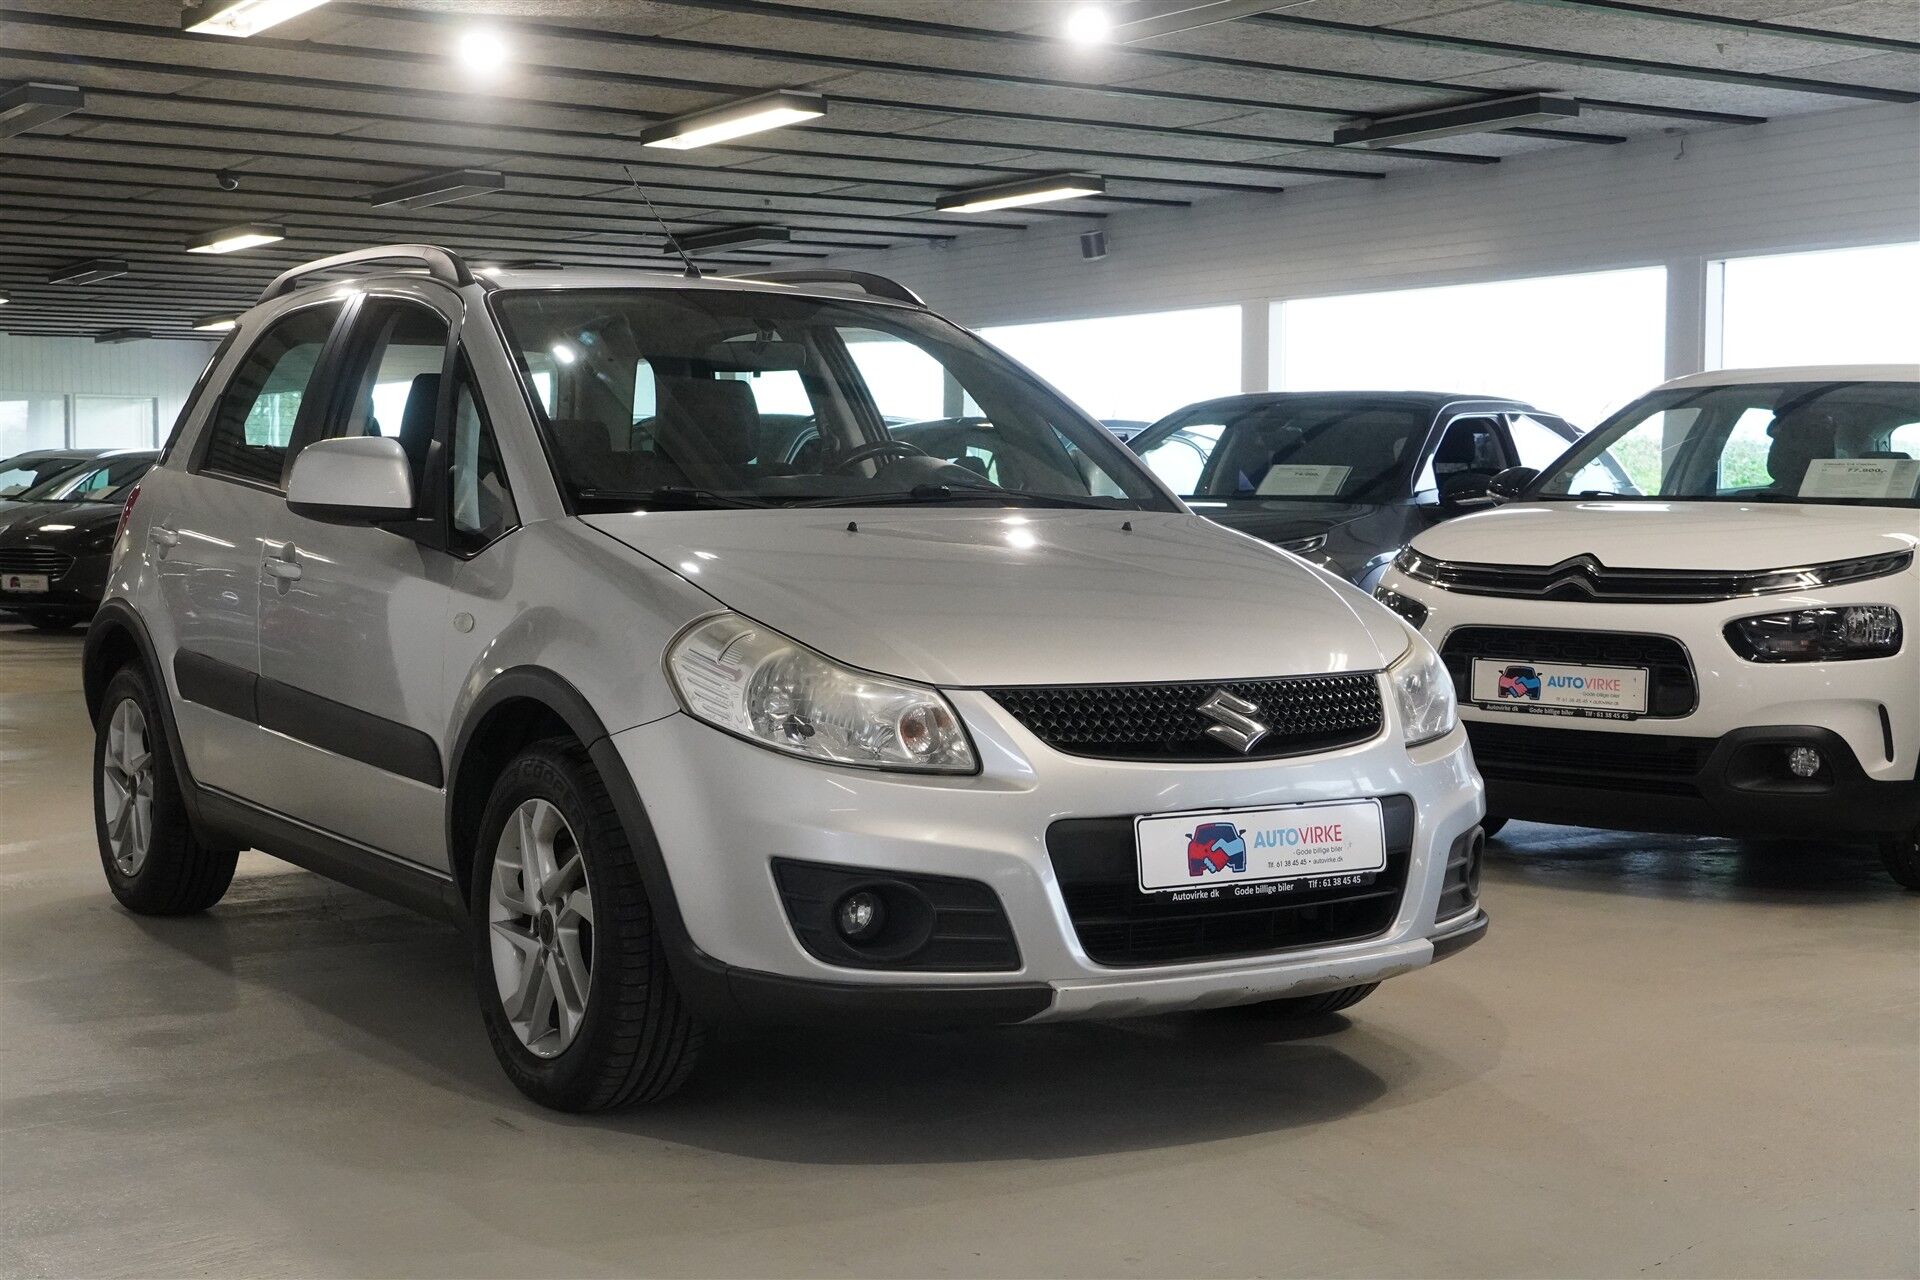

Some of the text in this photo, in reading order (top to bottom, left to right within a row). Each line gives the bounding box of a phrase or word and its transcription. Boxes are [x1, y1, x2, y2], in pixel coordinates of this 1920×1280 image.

[1547, 676, 1621, 691] AUTOVIRKE
[1253, 824, 1343, 848] AUTOVIRKE
[1313, 847, 1330, 855] billige
[1313, 857, 1344, 865] autovirke.dk
[1172, 889, 1209, 902] Autovirke
[1210, 888, 1220, 898] dk
[1234, 886, 1254, 896] Gode
[1255, 884, 1277, 895] billige
[1278, 882, 1294, 892] biler
[1322, 878, 1331, 887] 61
[1333, 877, 1342, 886] 38
[1343, 876, 1351, 885] 45
[1352, 875, 1361, 884] 45
